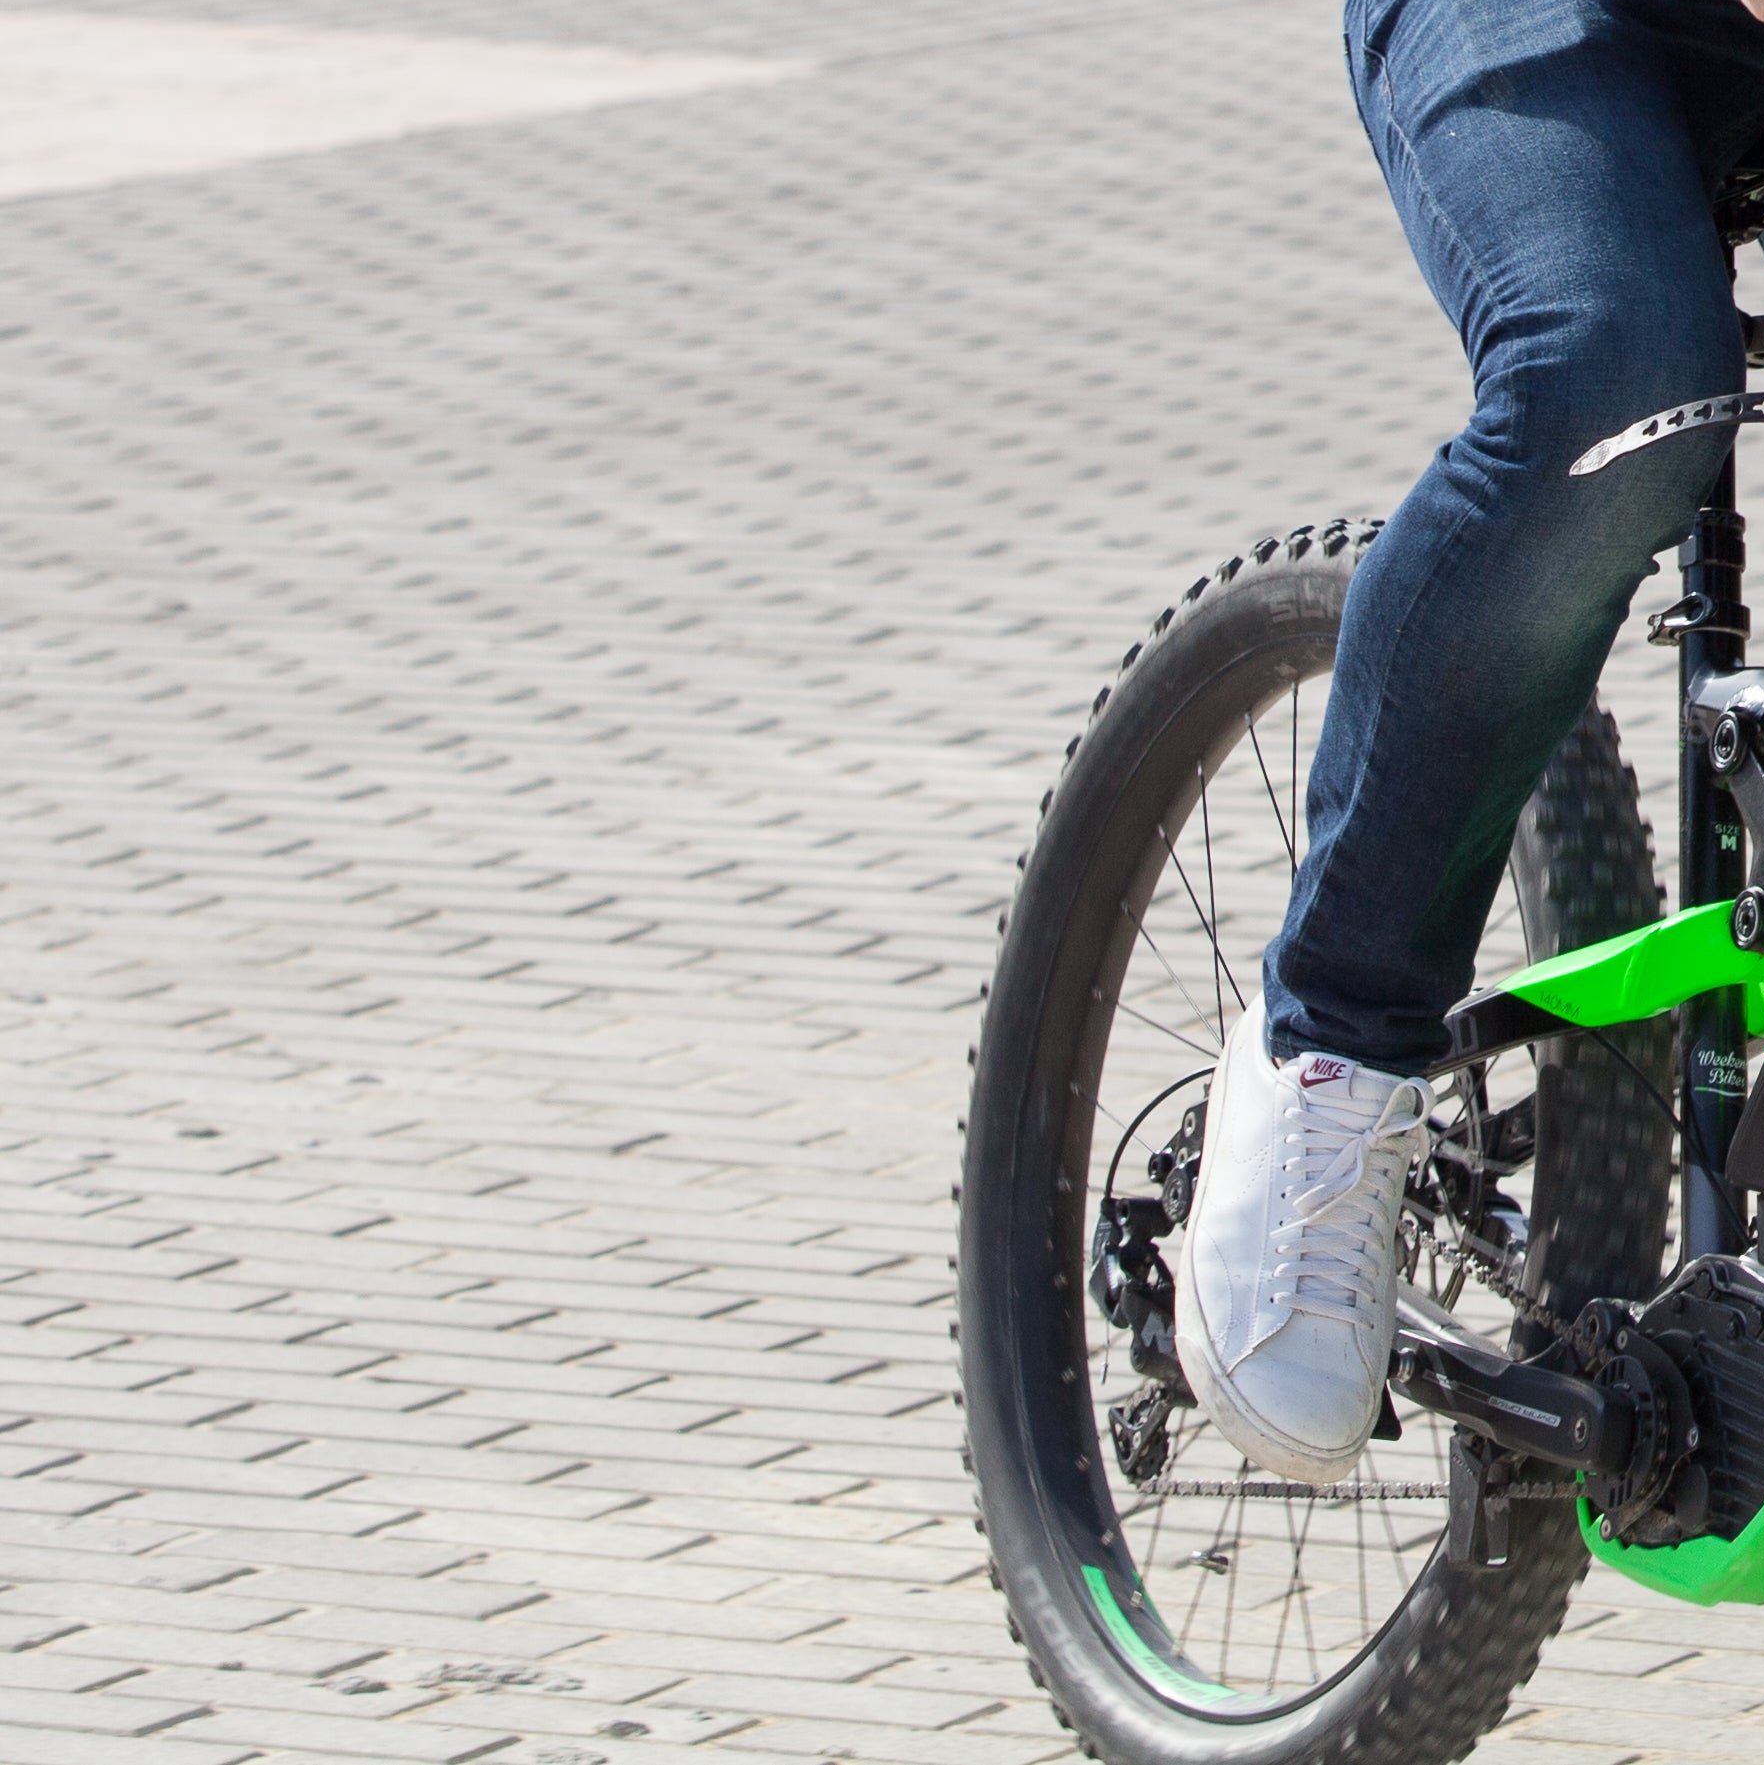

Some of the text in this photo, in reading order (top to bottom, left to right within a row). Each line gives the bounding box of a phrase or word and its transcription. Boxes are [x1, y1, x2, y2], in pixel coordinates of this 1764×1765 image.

[1714, 823, 1740, 836] SIZE
[1721, 834, 1737, 851] M
[1309, 1057, 1347, 1078] NIKE
[1698, 1050, 1746, 1069] Weeken
